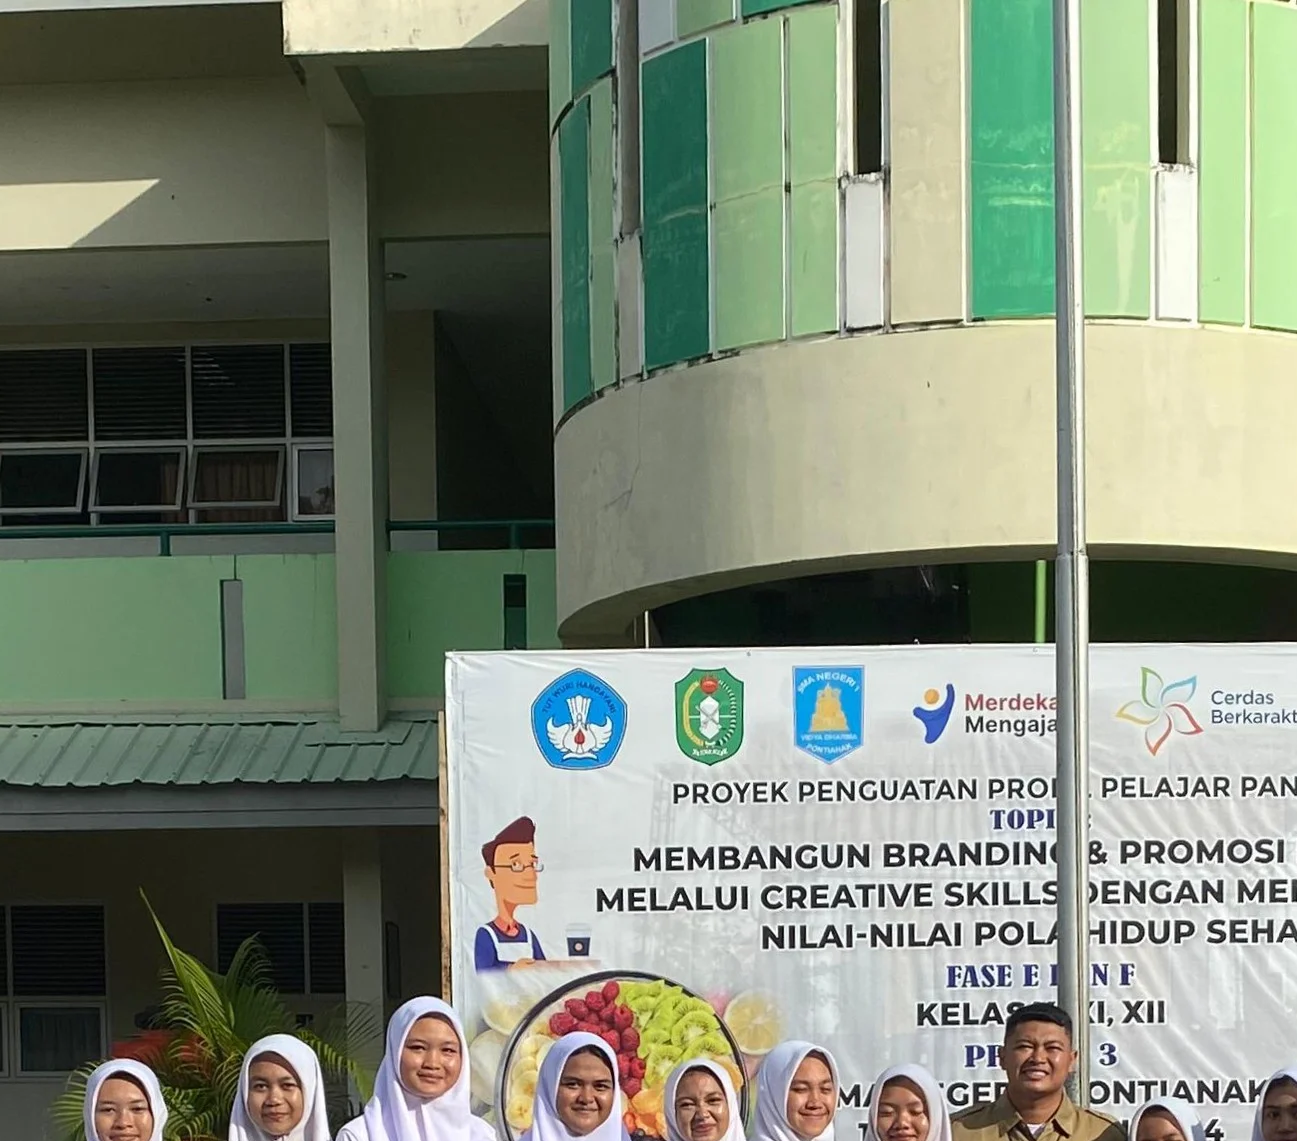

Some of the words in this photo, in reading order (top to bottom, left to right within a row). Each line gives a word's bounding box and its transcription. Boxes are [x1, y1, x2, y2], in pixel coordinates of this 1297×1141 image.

[816, 671, 856, 687] NEGERI
[1211, 690, 1274, 705] Cerdas
[965, 714, 1057, 737] Mengaja
[673, 781, 788, 804] PROYEK
[798, 779, 977, 803] PENGUATAN
[1102, 776, 1230, 798] PELAJAR
[990, 809, 1056, 830] TOPI
[634, 844, 870, 872] MEMBANGUN
[1090, 840, 1108, 865] &
[1120, 839, 1285, 864] PROMOSI
[596, 886, 749, 912] MELALUI
[760, 883, 933, 910] CREATIVE
[944, 880, 1057, 907] SKILLS
[762, 922, 962, 950] NILAI-NILAI
[946, 964, 1012, 988] FASE
[1023, 964, 1039, 987] E
[1119, 963, 1135, 986] F
[1122, 1000, 1165, 1024] XII
[1099, 1043, 1117, 1066] 3
[1089, 1079, 1266, 1104] ONTIANAK
